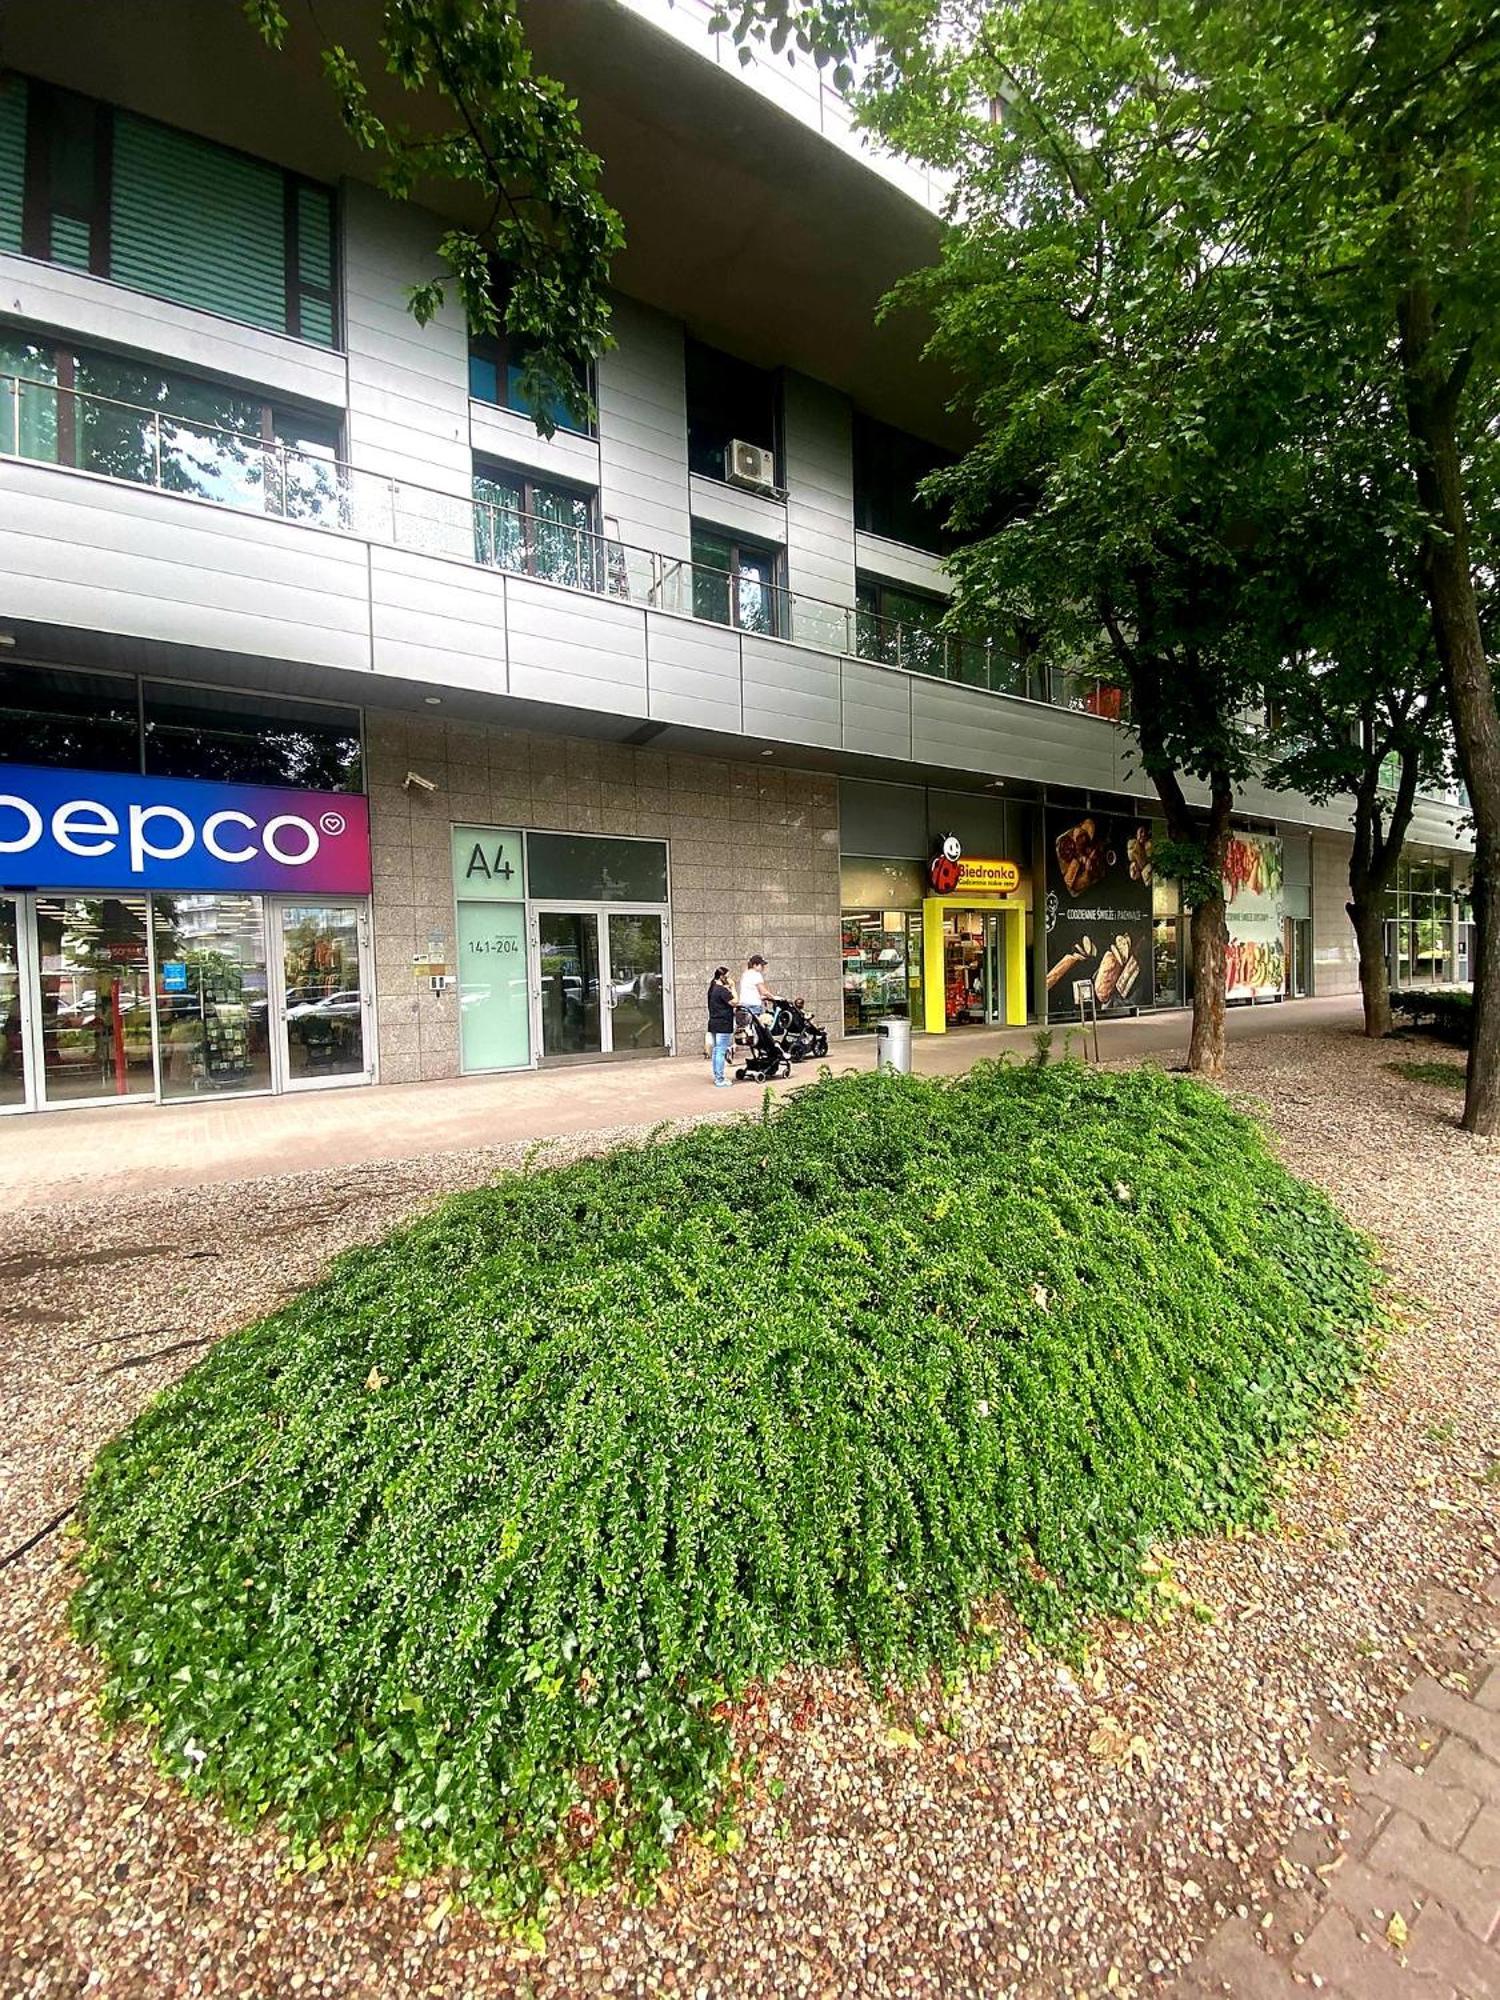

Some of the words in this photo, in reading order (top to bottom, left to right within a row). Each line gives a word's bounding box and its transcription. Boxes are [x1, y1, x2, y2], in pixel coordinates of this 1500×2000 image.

[466, 843, 515, 881] A4
[958, 864, 1015, 880] Biedronka
[469, 940, 519, 953] 141-204
